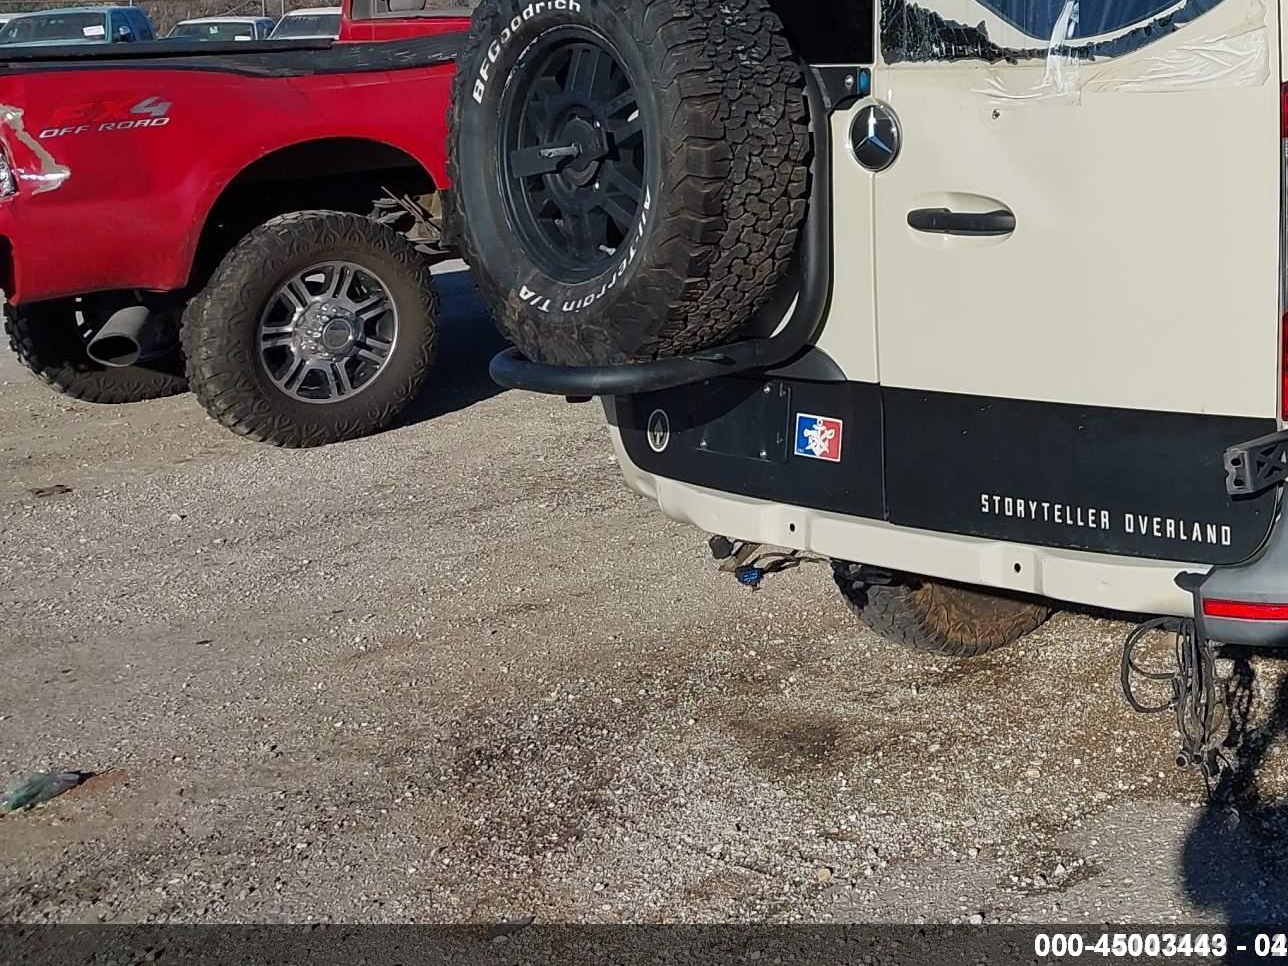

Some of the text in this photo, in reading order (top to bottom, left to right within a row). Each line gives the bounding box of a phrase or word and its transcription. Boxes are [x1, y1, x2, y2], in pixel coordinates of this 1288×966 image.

[39, 117, 171, 139] OFF ROAD
[519, 185, 651, 313] All-Terrain T/A
[981, 493, 1232, 546] STORYTELLER OVERLAND
